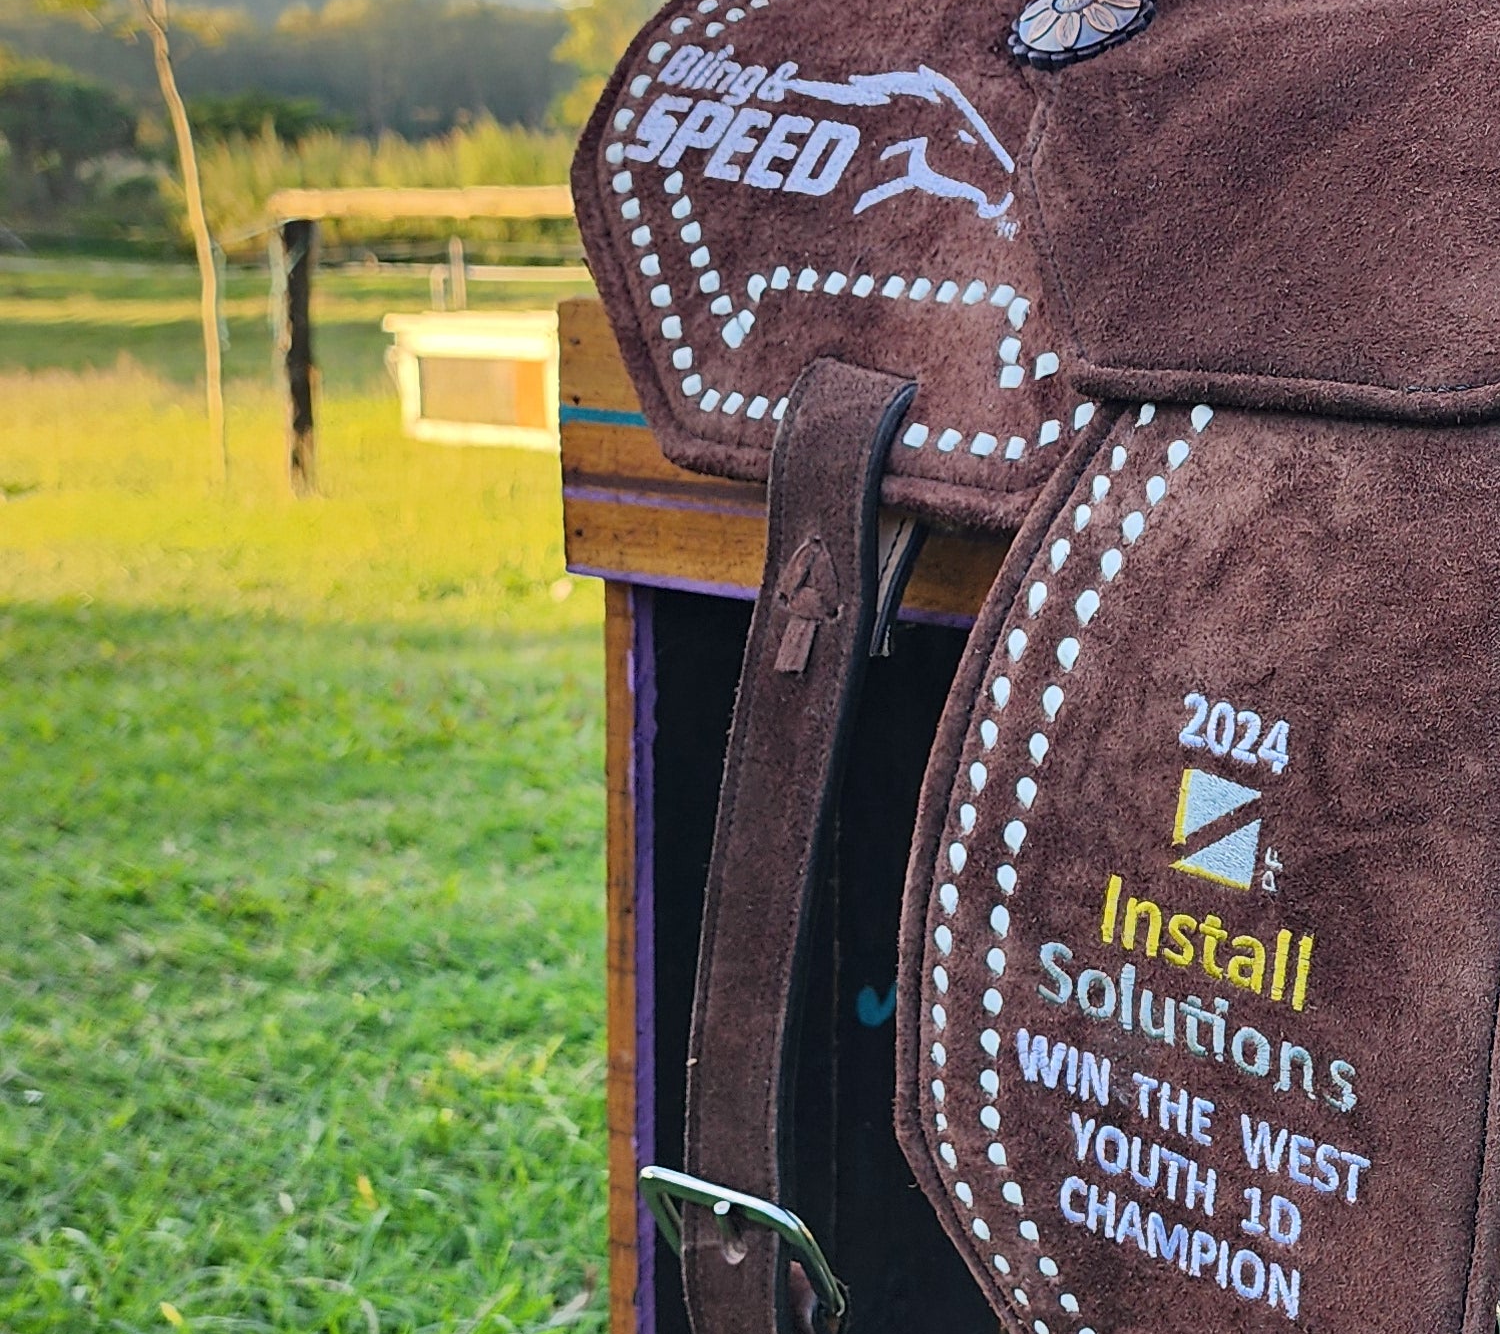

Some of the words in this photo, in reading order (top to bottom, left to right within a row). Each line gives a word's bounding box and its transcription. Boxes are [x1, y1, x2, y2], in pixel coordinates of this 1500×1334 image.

[656, 43, 768, 107] Bling
[623, 92, 861, 197] SPEED
[1178, 691, 1291, 775] 2024
[1102, 873, 1313, 1012] Install
[1038, 940, 1357, 1114] Solutions
[1016, 1027, 1111, 1107] WIN
[1133, 1071, 1216, 1146] THE
[1240, 1114, 1371, 1204] WEST
[1071, 1112, 1217, 1217] YOUTH
[1240, 1186, 1301, 1246] 1D
[1058, 1174, 1301, 1320] CHAMPION
